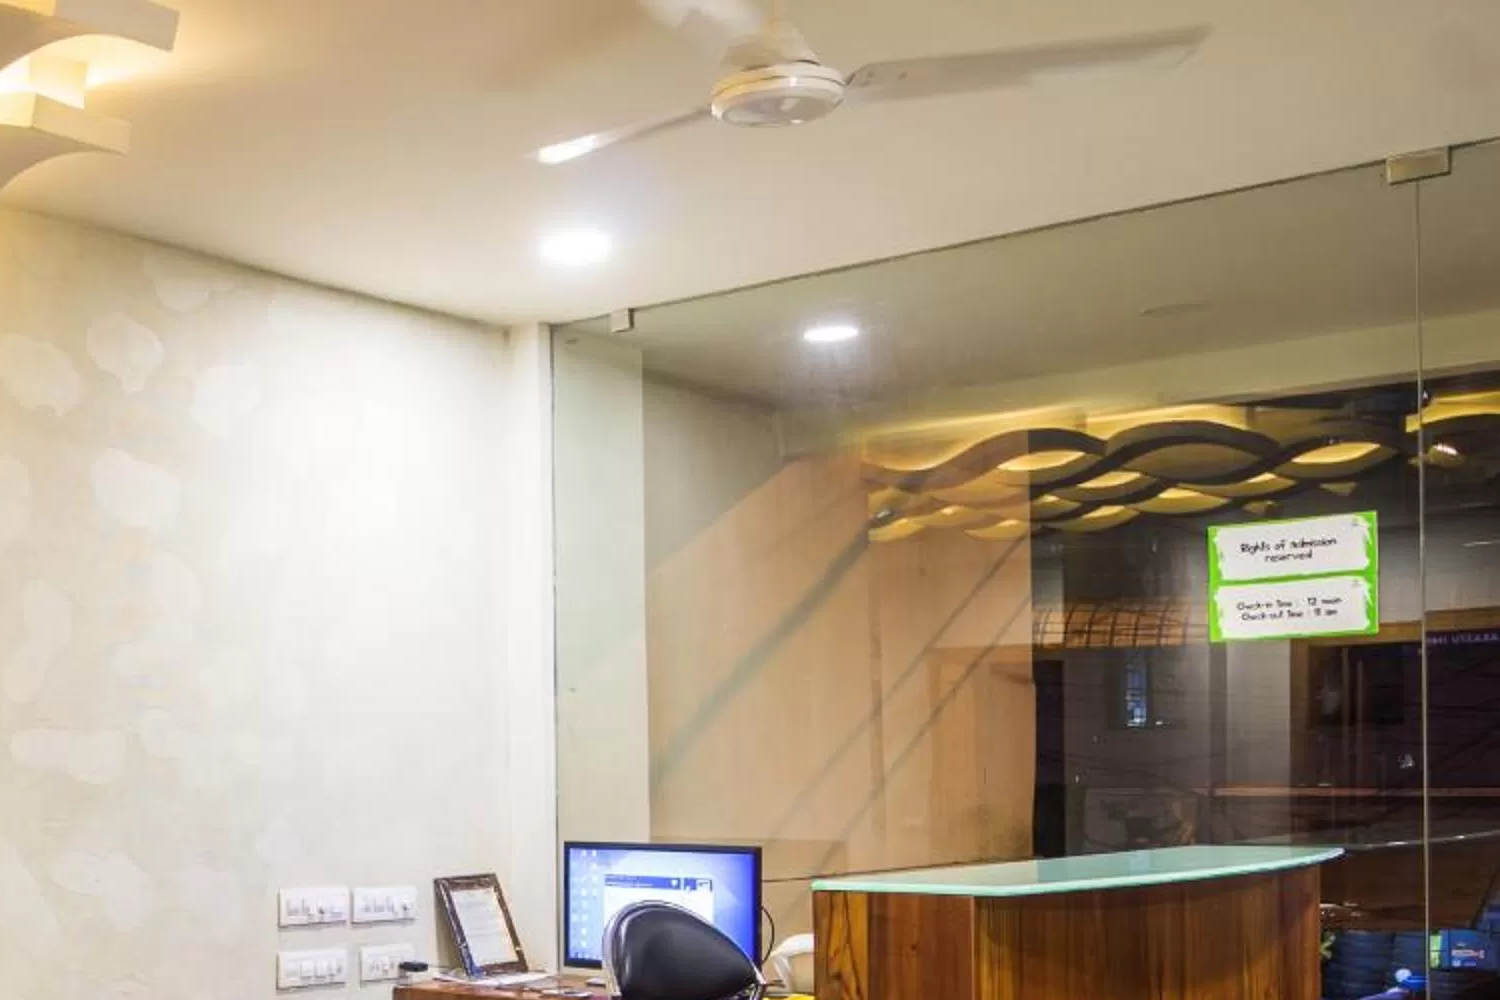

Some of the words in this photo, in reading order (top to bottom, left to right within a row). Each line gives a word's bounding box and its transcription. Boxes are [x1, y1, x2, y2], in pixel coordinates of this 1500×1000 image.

[1240, 541, 1270, 555] Rights
[1274, 540, 1285, 550] of
[1290, 537, 1337, 548] admission
[1264, 549, 1312, 562] reserved
